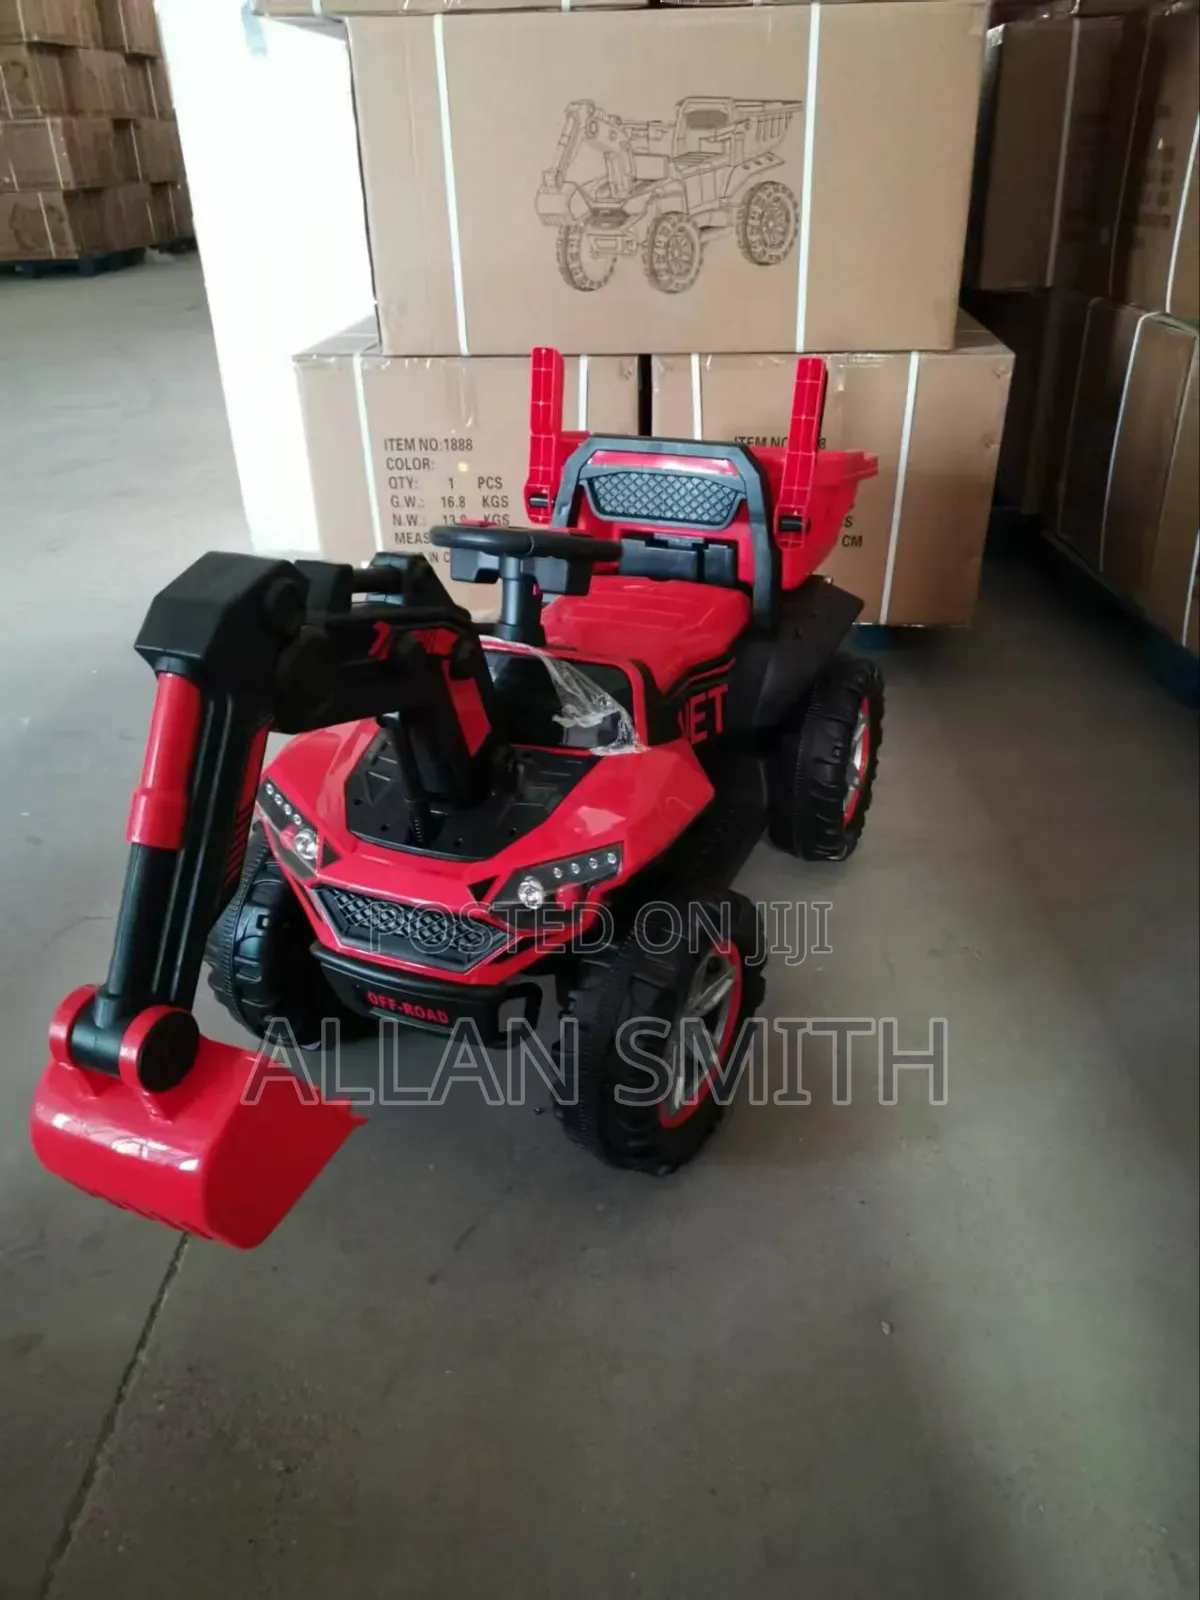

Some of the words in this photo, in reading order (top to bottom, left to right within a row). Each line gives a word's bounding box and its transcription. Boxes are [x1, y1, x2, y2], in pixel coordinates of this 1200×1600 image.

[384, 438, 415, 452] ITEM
[386, 457, 434, 471] COLOR:
[388, 476, 419, 490] QTY:
[448, 476, 455, 490] 1
[477, 476, 503, 490] PCS
[441, 495, 466, 509] 16.8
[482, 495, 509, 509] KGS
[842, 534, 863, 548] CM
[366, 991, 450, 1026] OFF-ROAD
